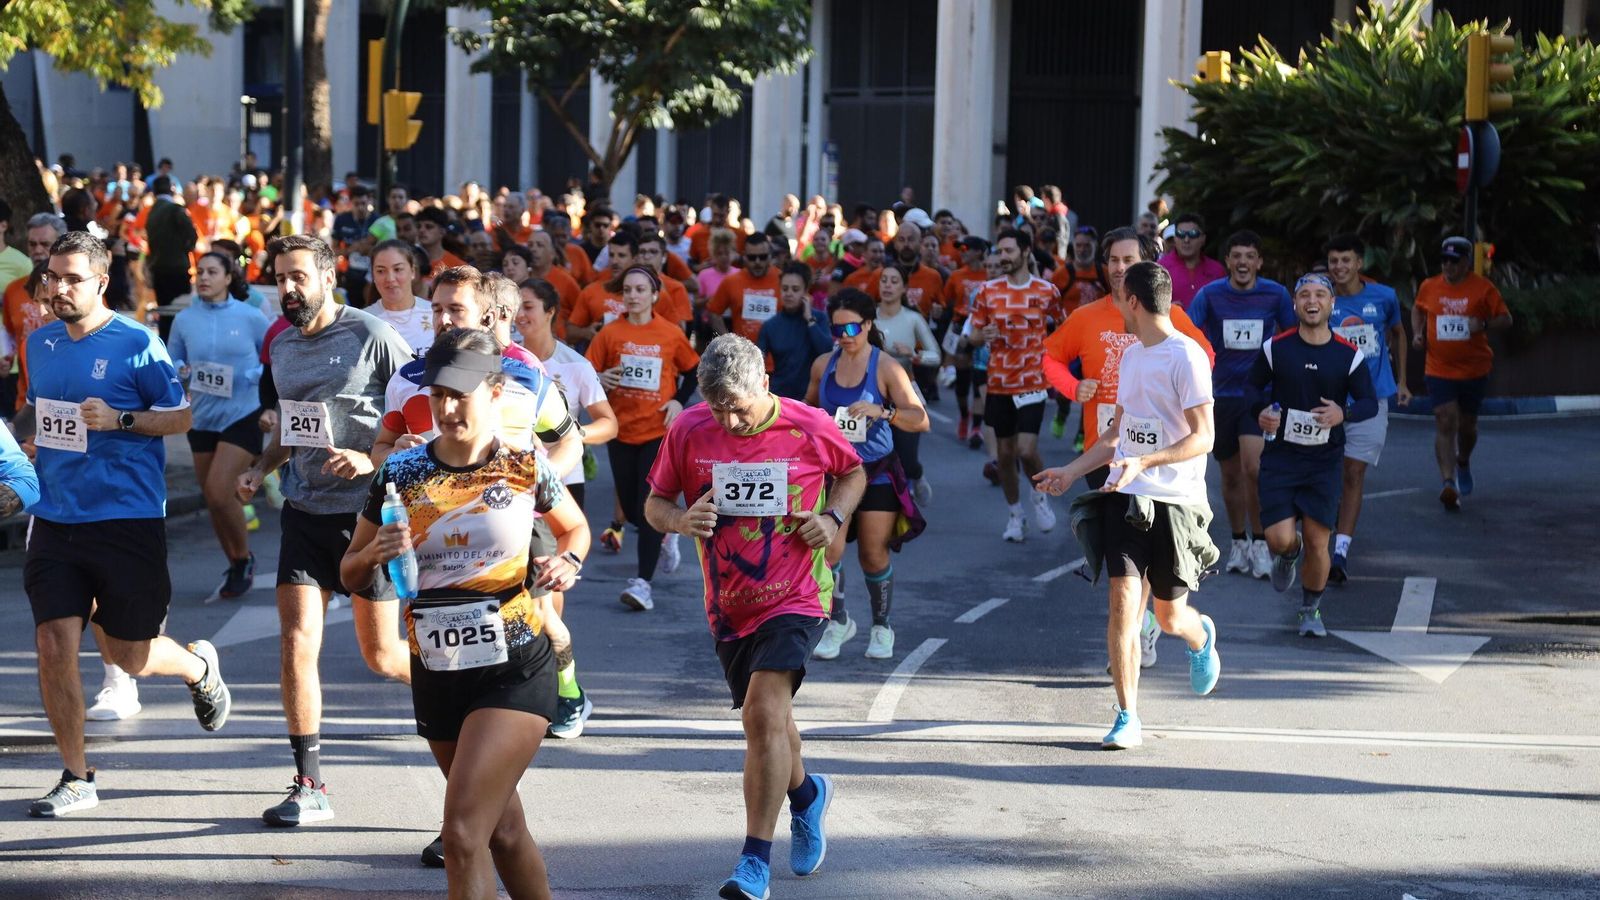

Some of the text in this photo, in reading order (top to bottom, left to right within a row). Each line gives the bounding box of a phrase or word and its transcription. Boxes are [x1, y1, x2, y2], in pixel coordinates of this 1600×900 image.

[1233, 330, 1250, 340] 71
[197, 370, 224, 386] 819
[625, 366, 653, 379] 261
[43, 416, 76, 436] 912
[291, 415, 321, 433] 247
[1293, 422, 1322, 436] 397
[1127, 428, 1158, 445] 1063
[725, 482, 775, 501] 372
[418, 551, 460, 560] AMINITO
[463, 550, 482, 559] DEL
[485, 549, 506, 558] REY
[427, 623, 496, 649] 1025
